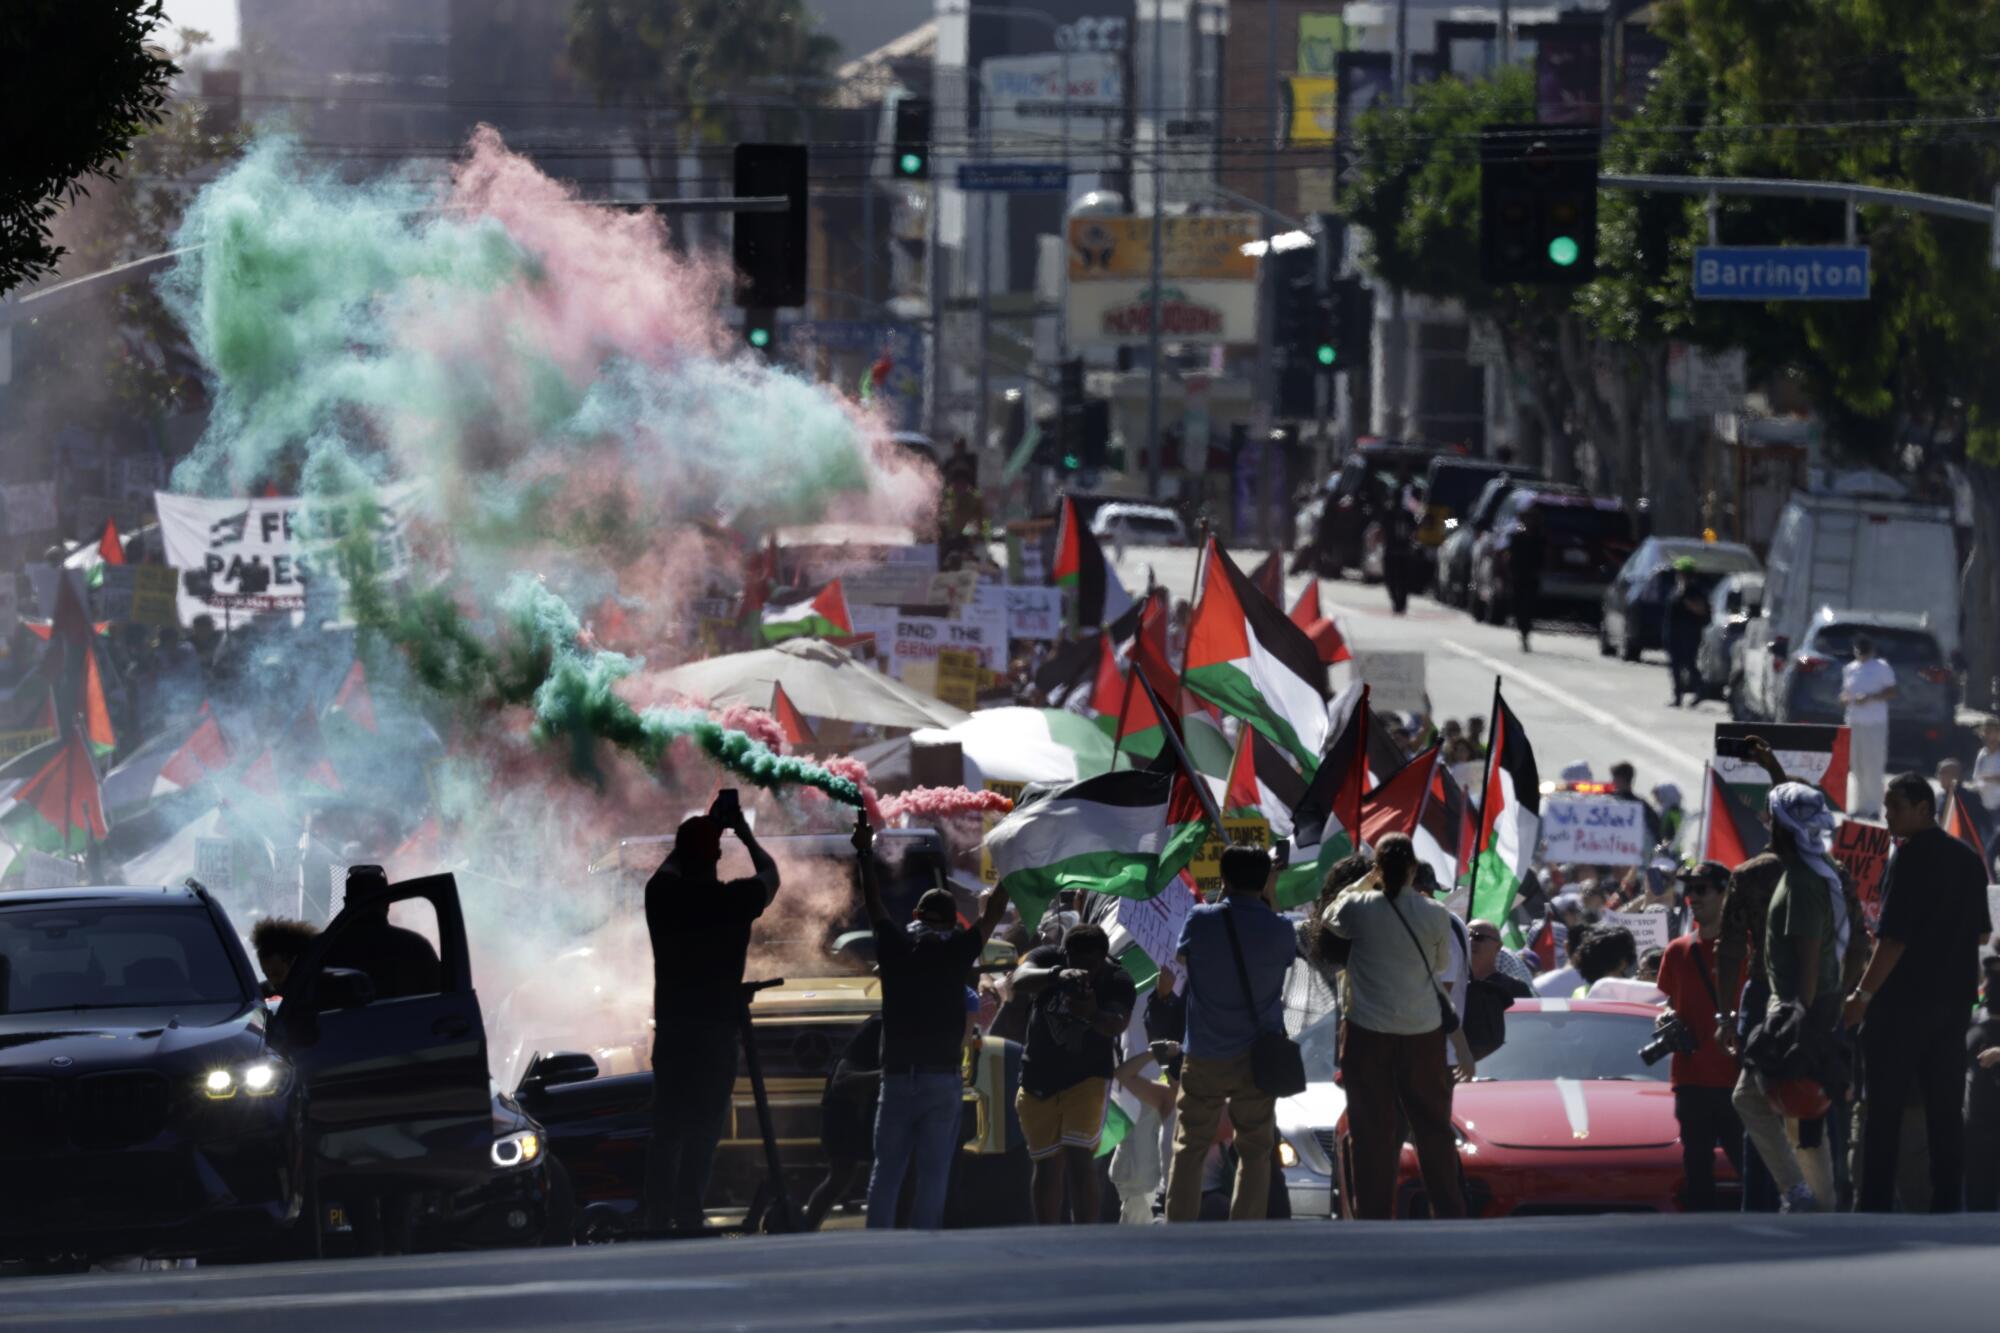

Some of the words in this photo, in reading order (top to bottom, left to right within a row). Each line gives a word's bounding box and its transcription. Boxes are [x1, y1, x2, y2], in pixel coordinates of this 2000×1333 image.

[1701, 258, 1862, 294] Barrington
[897, 622, 937, 640] END
[951, 626, 982, 642] THE
